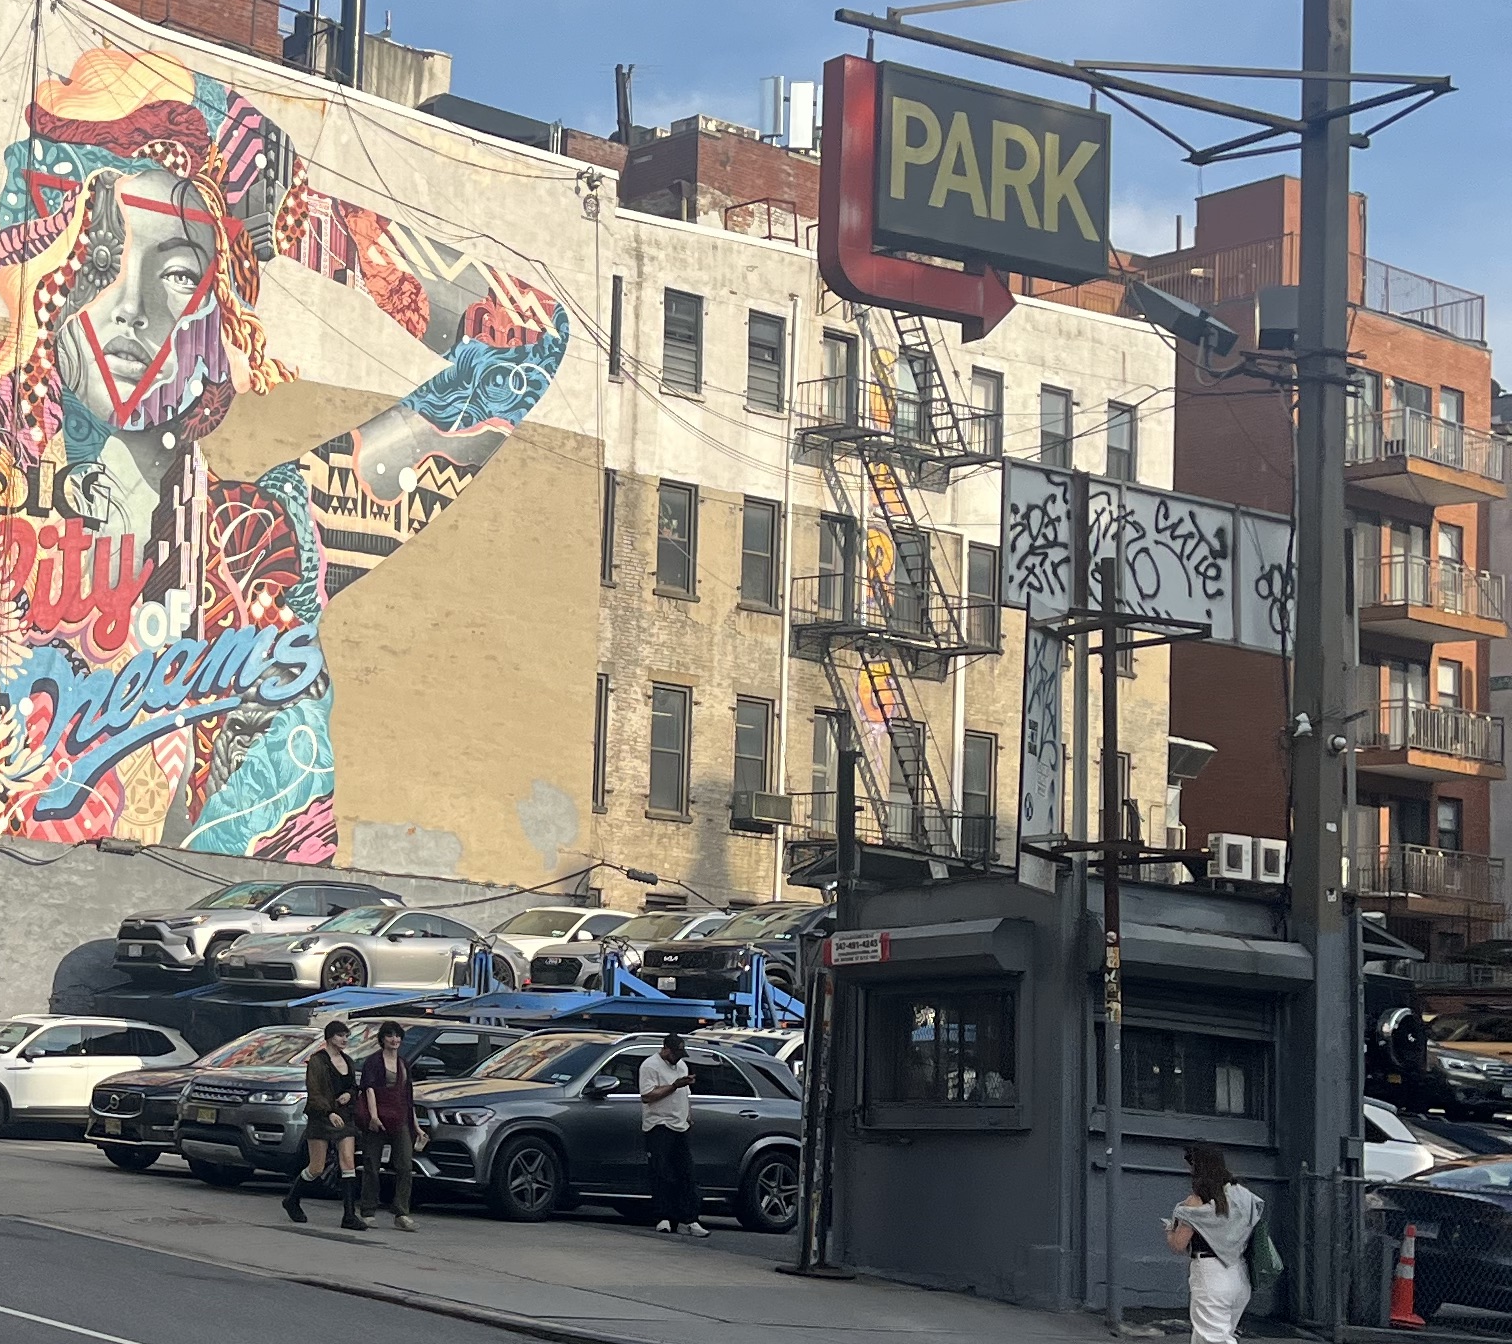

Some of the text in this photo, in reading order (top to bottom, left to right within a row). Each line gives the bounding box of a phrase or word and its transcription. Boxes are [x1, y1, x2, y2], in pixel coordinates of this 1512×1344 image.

[890, 96, 1100, 242] PARK
[138, 588, 192, 649] OF
[3, 622, 325, 768] Dreams
